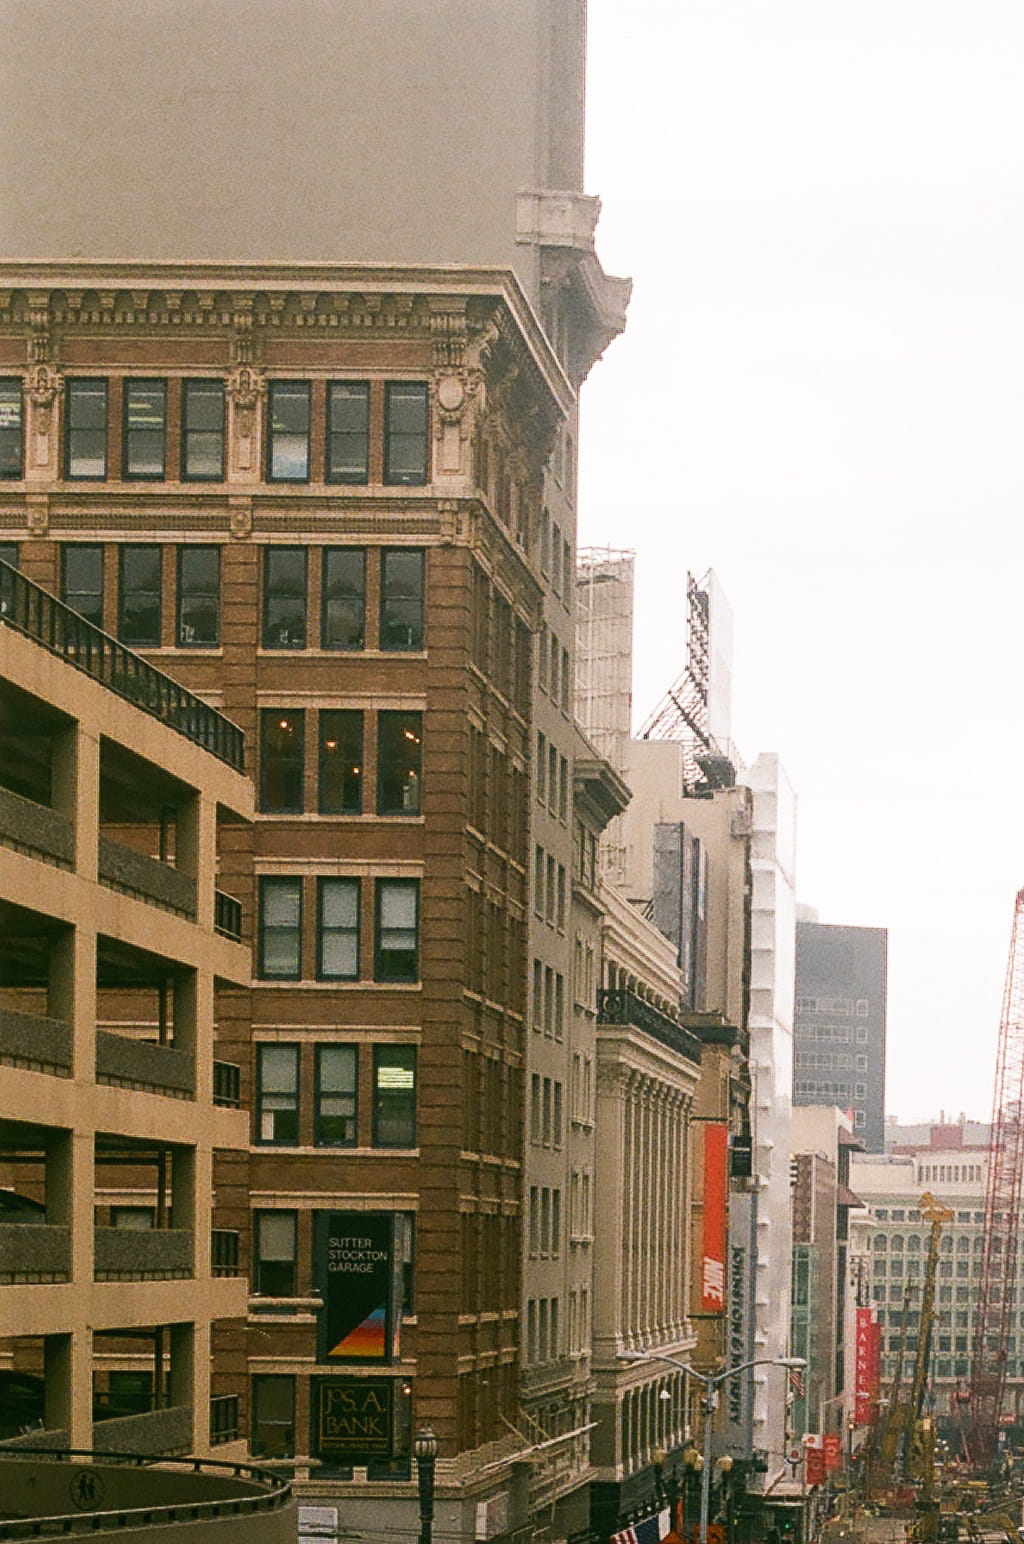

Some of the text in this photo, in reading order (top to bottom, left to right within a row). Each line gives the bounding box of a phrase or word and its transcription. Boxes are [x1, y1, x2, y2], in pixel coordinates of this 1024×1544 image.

[329, 1238, 372, 1248] SUTTER
[329, 1250, 388, 1261] STOCKTON
[329, 1263, 374, 1273] GARAGE
[703, 1256, 725, 1301] NIKE
[857, 1316, 868, 1415] BARNES
[326, 1416, 384, 1435] BANK
